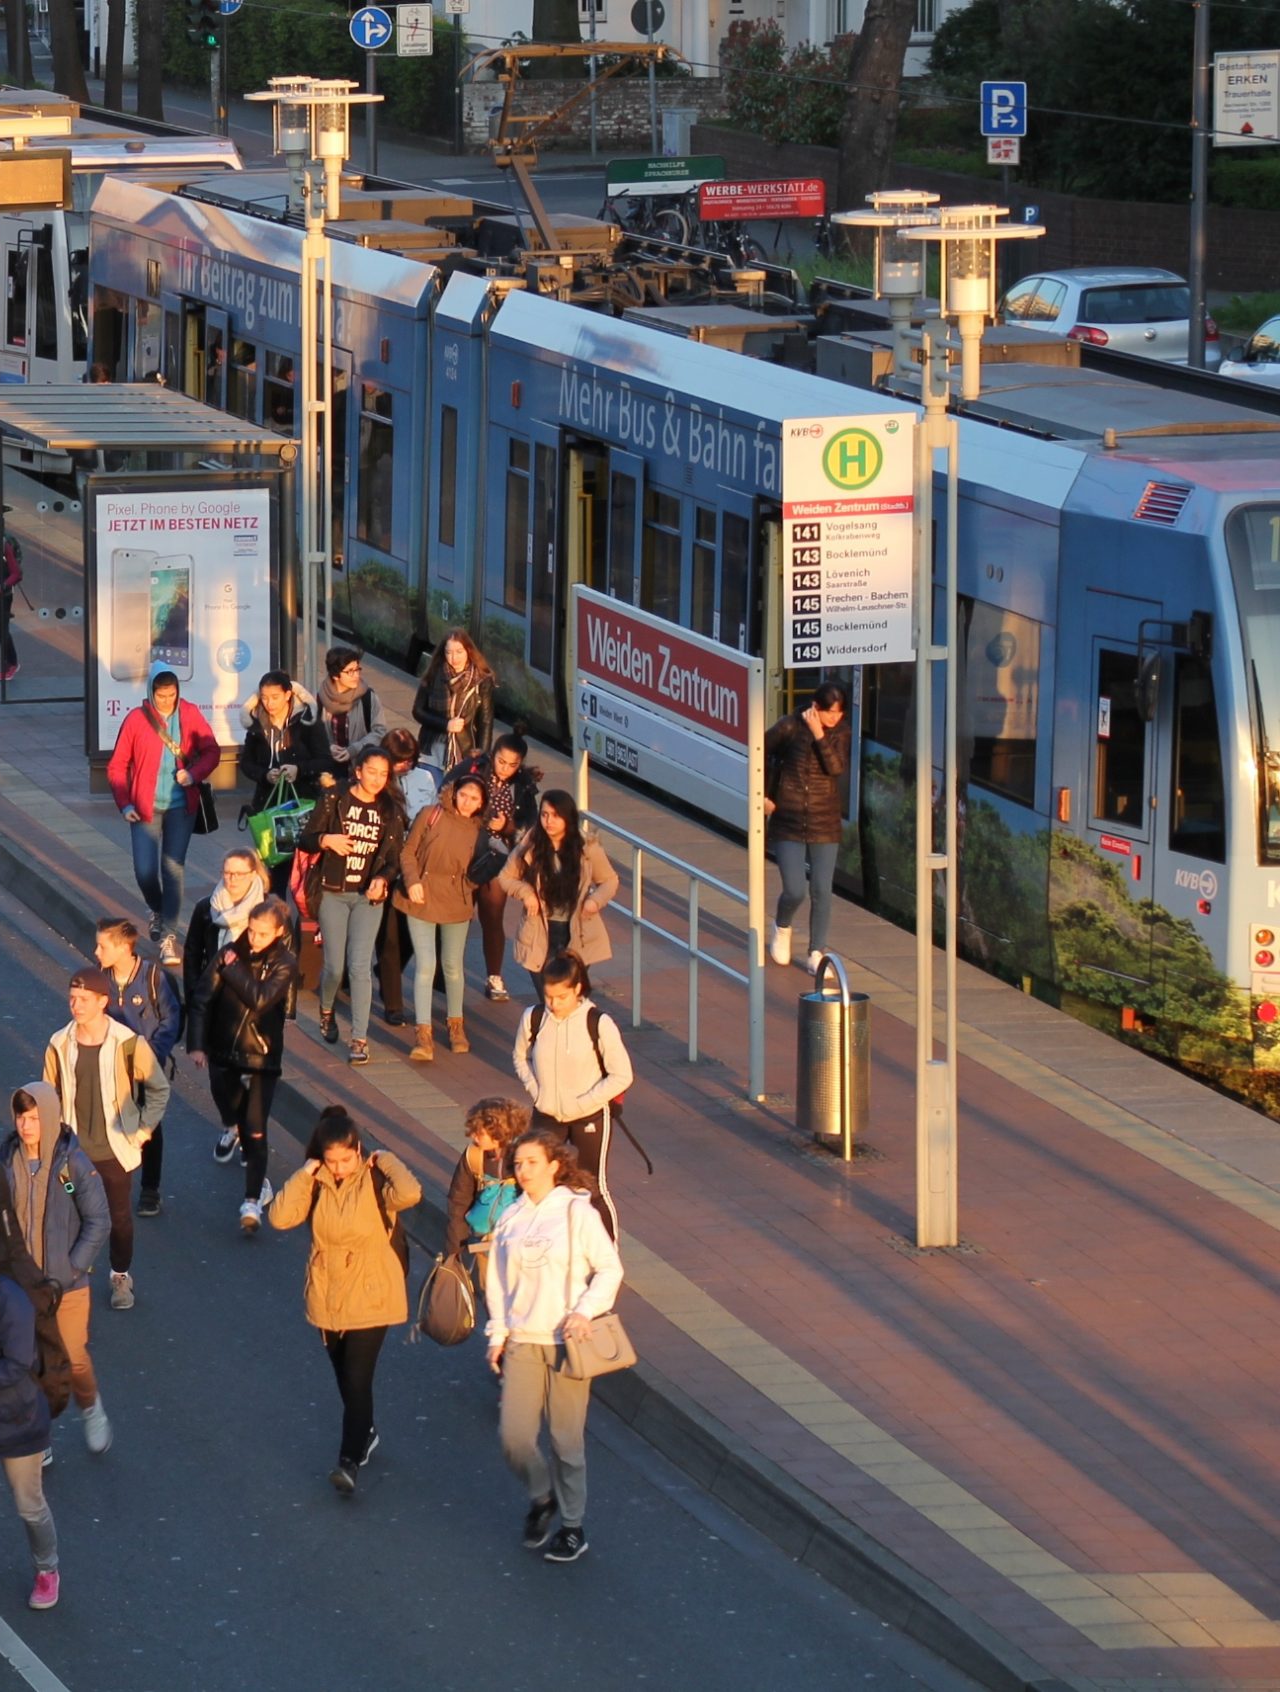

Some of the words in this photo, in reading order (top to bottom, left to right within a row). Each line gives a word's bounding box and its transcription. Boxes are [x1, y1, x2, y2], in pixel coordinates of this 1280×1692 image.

[1218, 62, 1277, 71] Bestattungen
[1227, 74, 1268, 86] ERKEN
[1224, 90, 1272, 98] Trauerhalle
[991, 89, 1016, 129] P
[705, 182, 819, 197] WERBE-WERKSTATT.de
[1025, 207, 1036, 222] P
[179, 236, 199, 294] Ihr
[200, 246, 256, 330] Beitrag
[258, 275, 294, 326] zum
[558, 361, 614, 434] Mehr
[618, 381, 656, 450] Bus
[662, 391, 681, 459] &
[688, 403, 746, 481] Bahn
[790, 427, 810, 438] KVB
[839, 440, 867, 478] H
[107, 503, 138, 516] Pixel.
[140, 503, 178, 515] Phone
[181, 502, 195, 516] by
[198, 501, 241, 516] Google
[792, 504, 832, 515] Weiden
[834, 502, 880, 513] Zentrum
[108, 519, 146, 532] JETZT
[150, 519, 166, 531] IM
[169, 517, 220, 531] BESTEN
[224, 517, 259, 530] NETZ
[793, 525, 820, 541] 141
[825, 520, 878, 533] Vogelsang
[793, 549, 820, 565] 143
[825, 547, 888, 560] Bocklemünd
[793, 573, 820, 588] 143
[825, 568, 871, 580] Lövenich
[825, 579, 868, 589] Saarstraße
[793, 597, 820, 613] 145
[825, 593, 863, 603] Frechen
[870, 590, 909, 601] Bachem
[793, 621, 820, 637] 145
[825, 619, 888, 633] Bocklemünd
[793, 645, 820, 660] 149
[825, 642, 888, 656] Widdersdorf
[587, 613, 654, 690] Weiden
[658, 644, 739, 728] Zentrum
[346, 856, 366, 871] YOU
[1175, 868, 1200, 891] KVB
